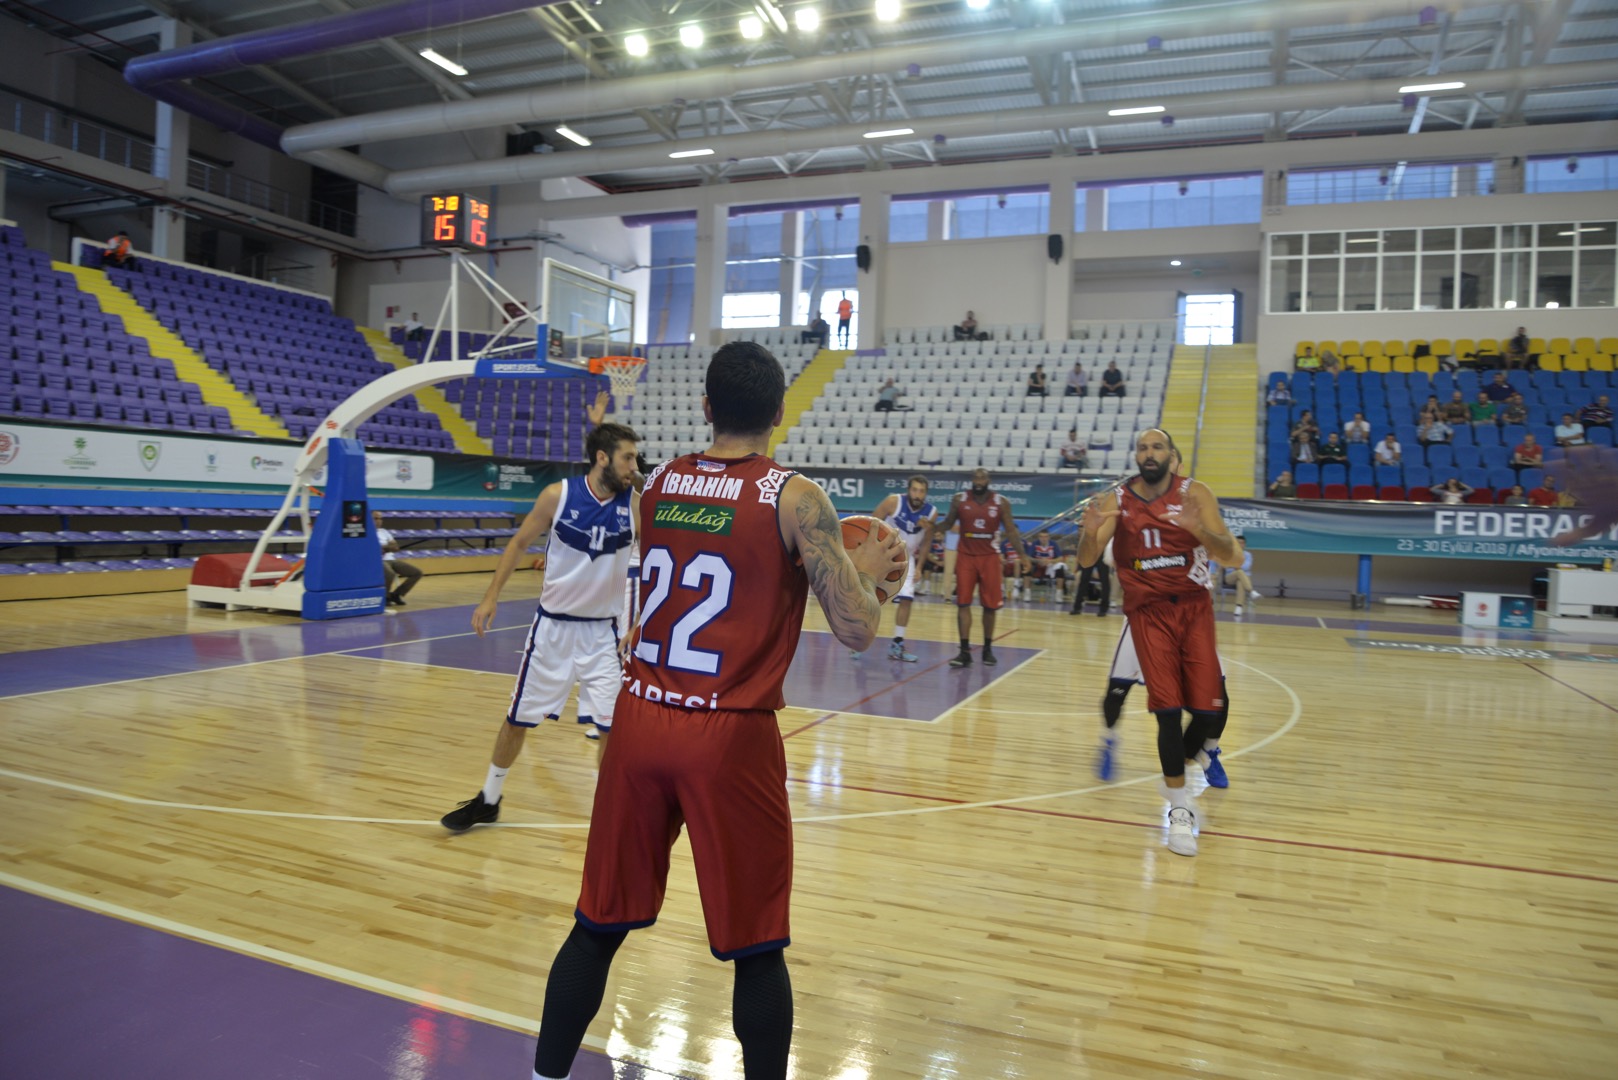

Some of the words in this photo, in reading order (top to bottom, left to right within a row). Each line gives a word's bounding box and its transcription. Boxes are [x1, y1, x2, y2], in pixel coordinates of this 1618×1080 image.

[661, 469, 744, 500] İBRAHİM
[655, 505, 732, 533] uludağ
[589, 525, 606, 551] 11
[1141, 528, 1161, 549] 11
[1397, 539, 1414, 551] 23
[1424, 540, 1438, 552] 30
[1473, 541, 1508, 555] 2018
[633, 546, 736, 675] 22
